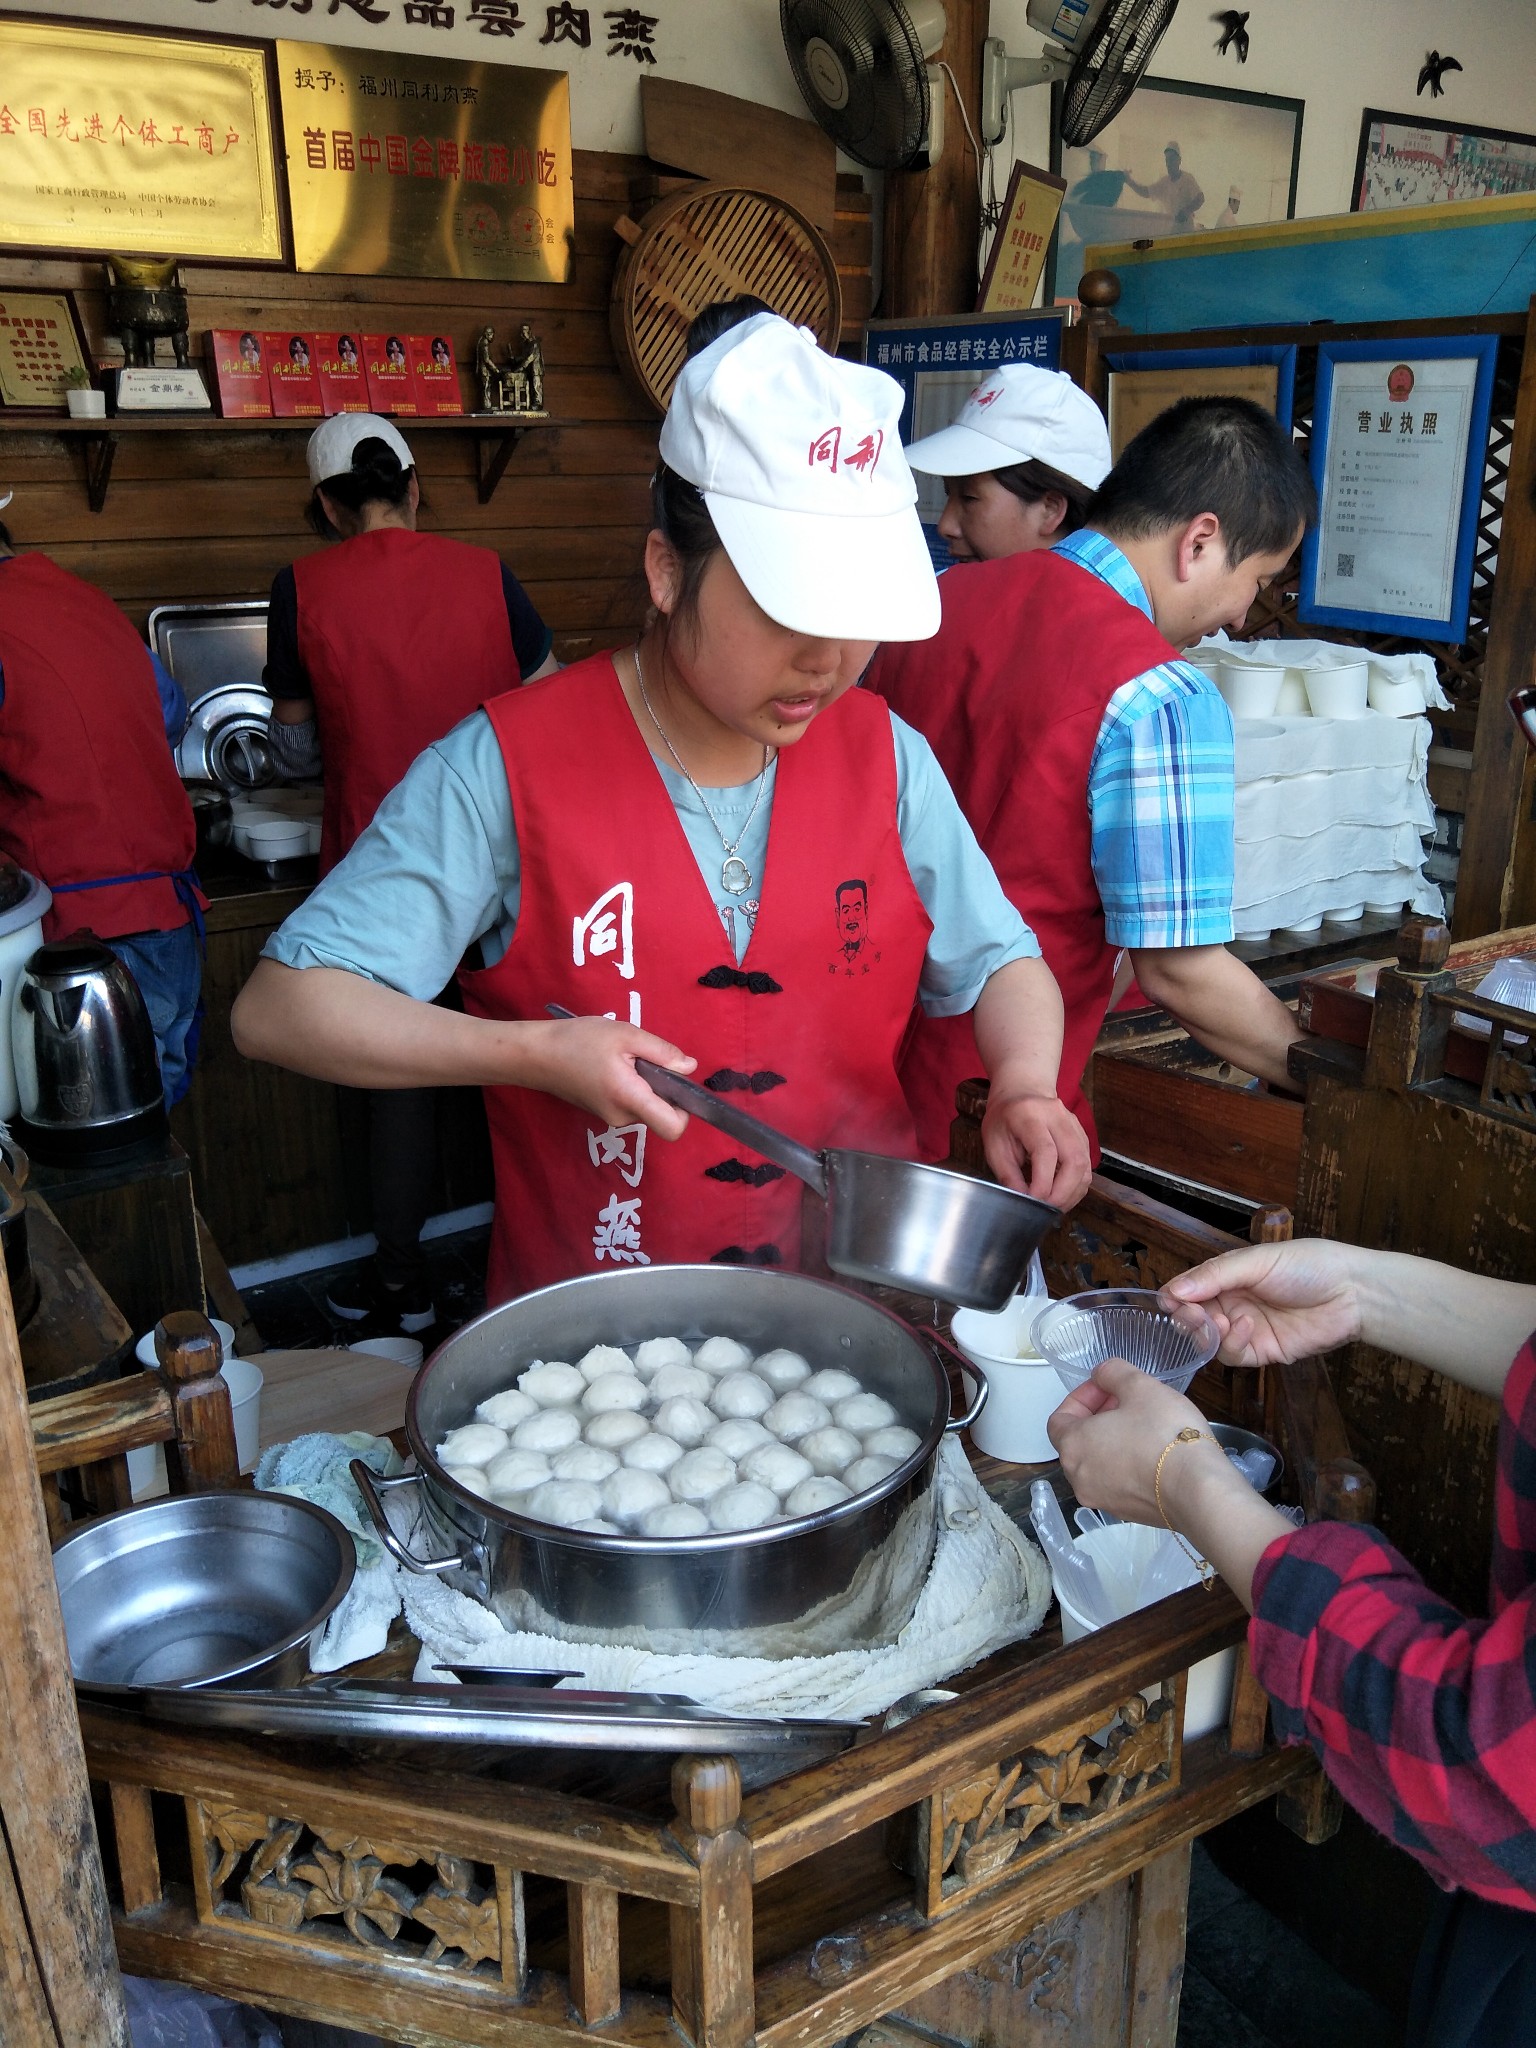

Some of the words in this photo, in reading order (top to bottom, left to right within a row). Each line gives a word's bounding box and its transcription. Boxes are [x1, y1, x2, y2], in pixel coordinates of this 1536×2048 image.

[0, 103, 241, 156] 全国先进个体工商户
[303, 125, 558, 187] 首届中国金牌旅游小吃
[878, 335, 1048, 364] 福州市食品经营安全公示栏
[1358, 411, 1437, 435] 营业执照
[808, 426, 884, 483] 同利
[573, 881, 651, 1264] 同肉燕
